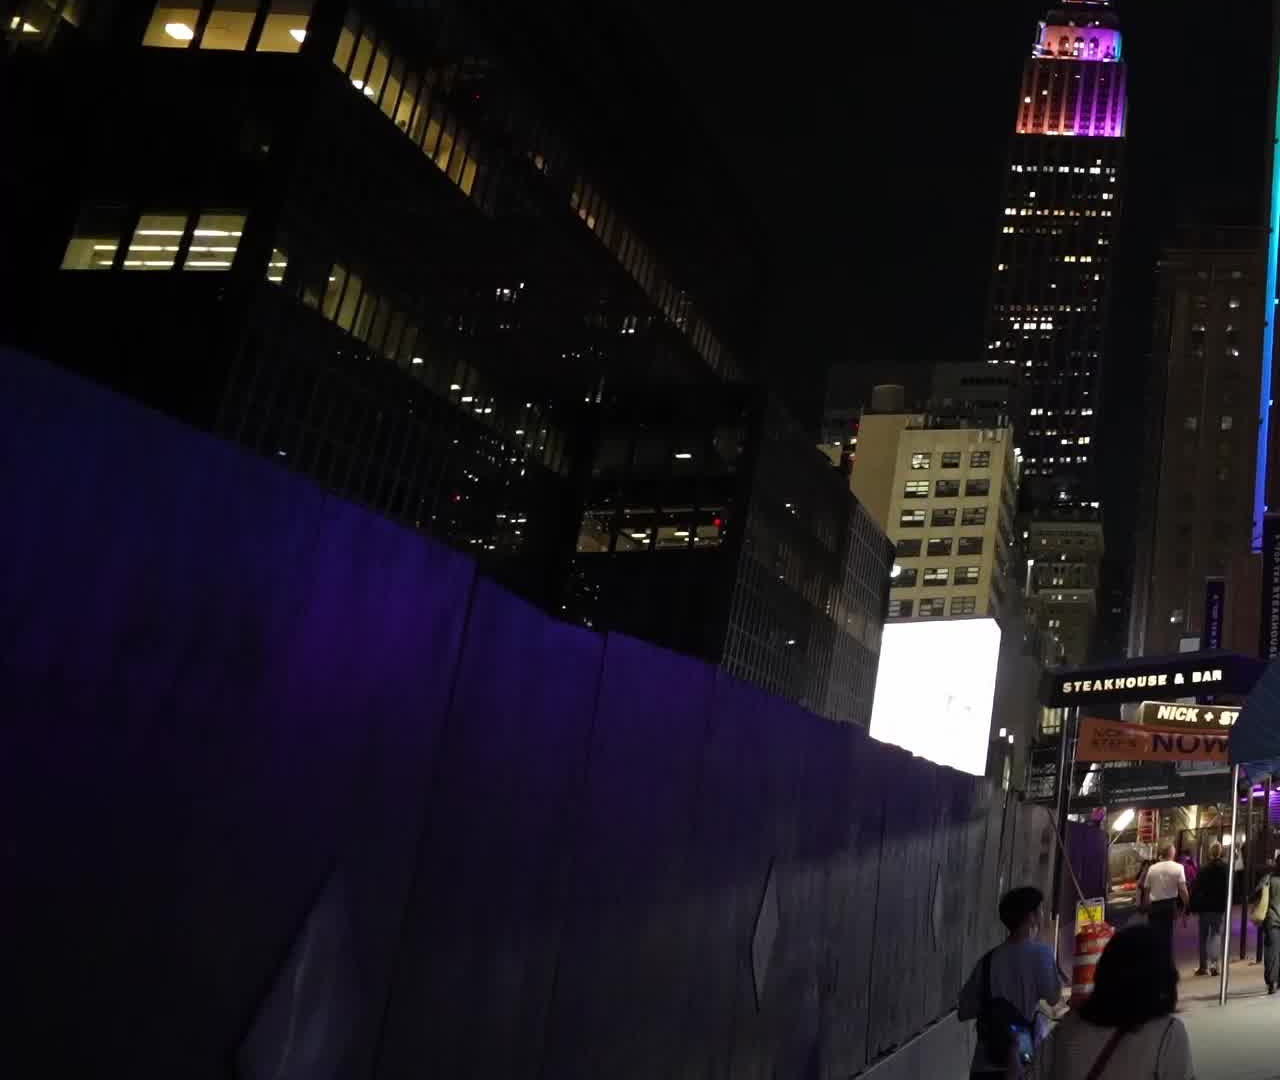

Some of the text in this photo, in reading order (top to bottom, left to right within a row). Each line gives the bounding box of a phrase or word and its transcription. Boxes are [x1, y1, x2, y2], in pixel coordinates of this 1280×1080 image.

[1062, 669, 1223, 693] STEAKHOUSE & BAR
[1157, 705, 1200, 722] NICK
